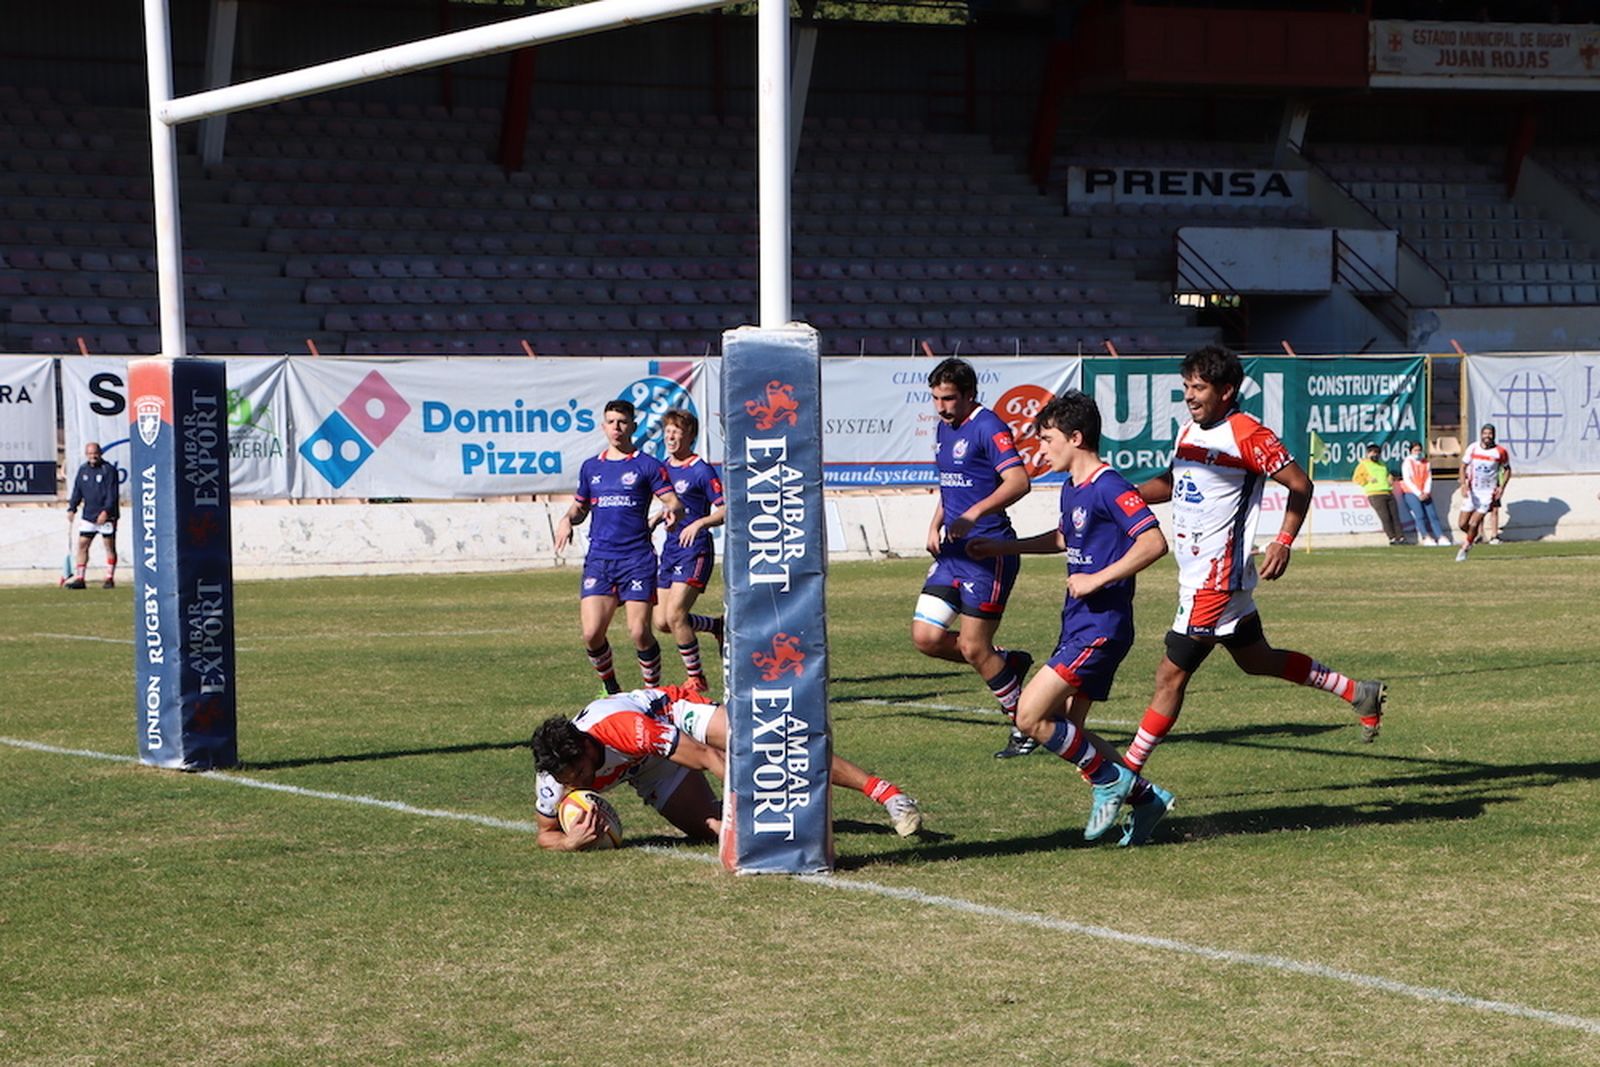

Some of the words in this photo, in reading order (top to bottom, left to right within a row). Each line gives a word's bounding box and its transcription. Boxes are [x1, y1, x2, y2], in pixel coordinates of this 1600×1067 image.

[1413, 29, 1456, 45] ESTADIO
[1460, 31, 1516, 47] MUNICIPAL
[1520, 32, 1533, 47] DE
[1537, 32, 1572, 48] RUGBY
[1435, 49, 1485, 67] JUAN
[1492, 50, 1549, 68] ROJAS
[1085, 169, 1292, 197] PRENSA
[1307, 374, 1417, 396] CONSTRUYENDO
[1581, 366, 1600, 408] J
[422, 399, 595, 433] Domino's
[825, 418, 894, 434] SYSTEM
[1306, 396, 1417, 433] ALMERÍA
[183, 414, 198, 484] AMBAR
[192, 389, 219, 507] EXPORT
[462, 441, 562, 475] Pizza
[1312, 442, 1341, 463] 50
[1346, 442, 1373, 463] 30
[1381, 440, 1411, 461] 046
[142, 464, 157, 572] ALMERIA
[745, 436, 790, 593] EXPORT
[780, 465, 806, 561] AMBAR
[1341, 512, 1378, 527] Rise.
[144, 584, 163, 664] RUGBY
[188, 603, 204, 672] AMBAR
[197, 578, 225, 695] EXPORT
[147, 676, 163, 750] UNION
[751, 686, 795, 840] EXPORT
[786, 715, 810, 810] AMBAR
